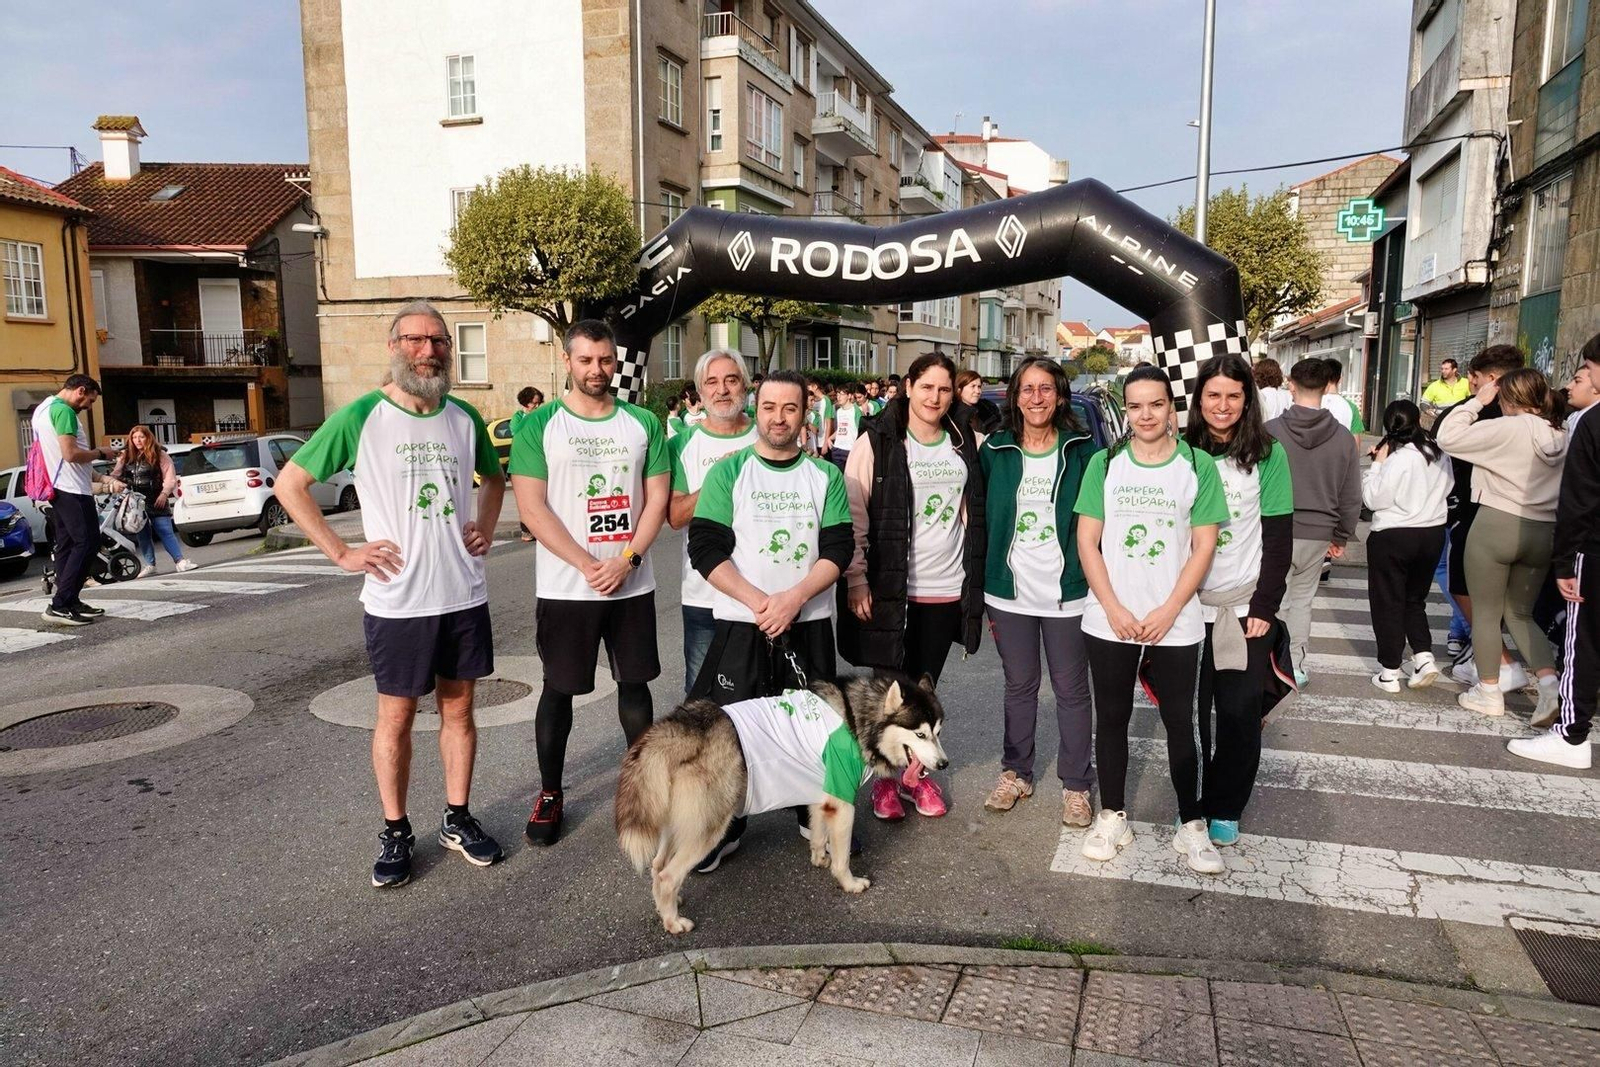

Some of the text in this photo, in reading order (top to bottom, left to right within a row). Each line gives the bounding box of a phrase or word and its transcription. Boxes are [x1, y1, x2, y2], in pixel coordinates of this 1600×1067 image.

[1344, 213, 1375, 227] 10:45
[769, 227, 982, 281] RODOSA
[1078, 215, 1199, 289] ALPINE
[619, 266, 692, 320] DACIA
[395, 441, 447, 454] CARRERA
[568, 436, 616, 448] CARRERA
[576, 446, 630, 458] SOLIDARIA
[404, 453, 459, 466] SOLIDARIA
[908, 459, 951, 469] CARRERA
[916, 468, 964, 479] SOLIDARIA
[1024, 476, 1052, 487] RERA
[750, 490, 801, 501] CARRERA
[1112, 485, 1165, 496] CARRERA
[757, 501, 815, 512] SOLIDARIA
[1117, 496, 1177, 509] SOLIDARIA
[590, 513, 630, 533] 254
